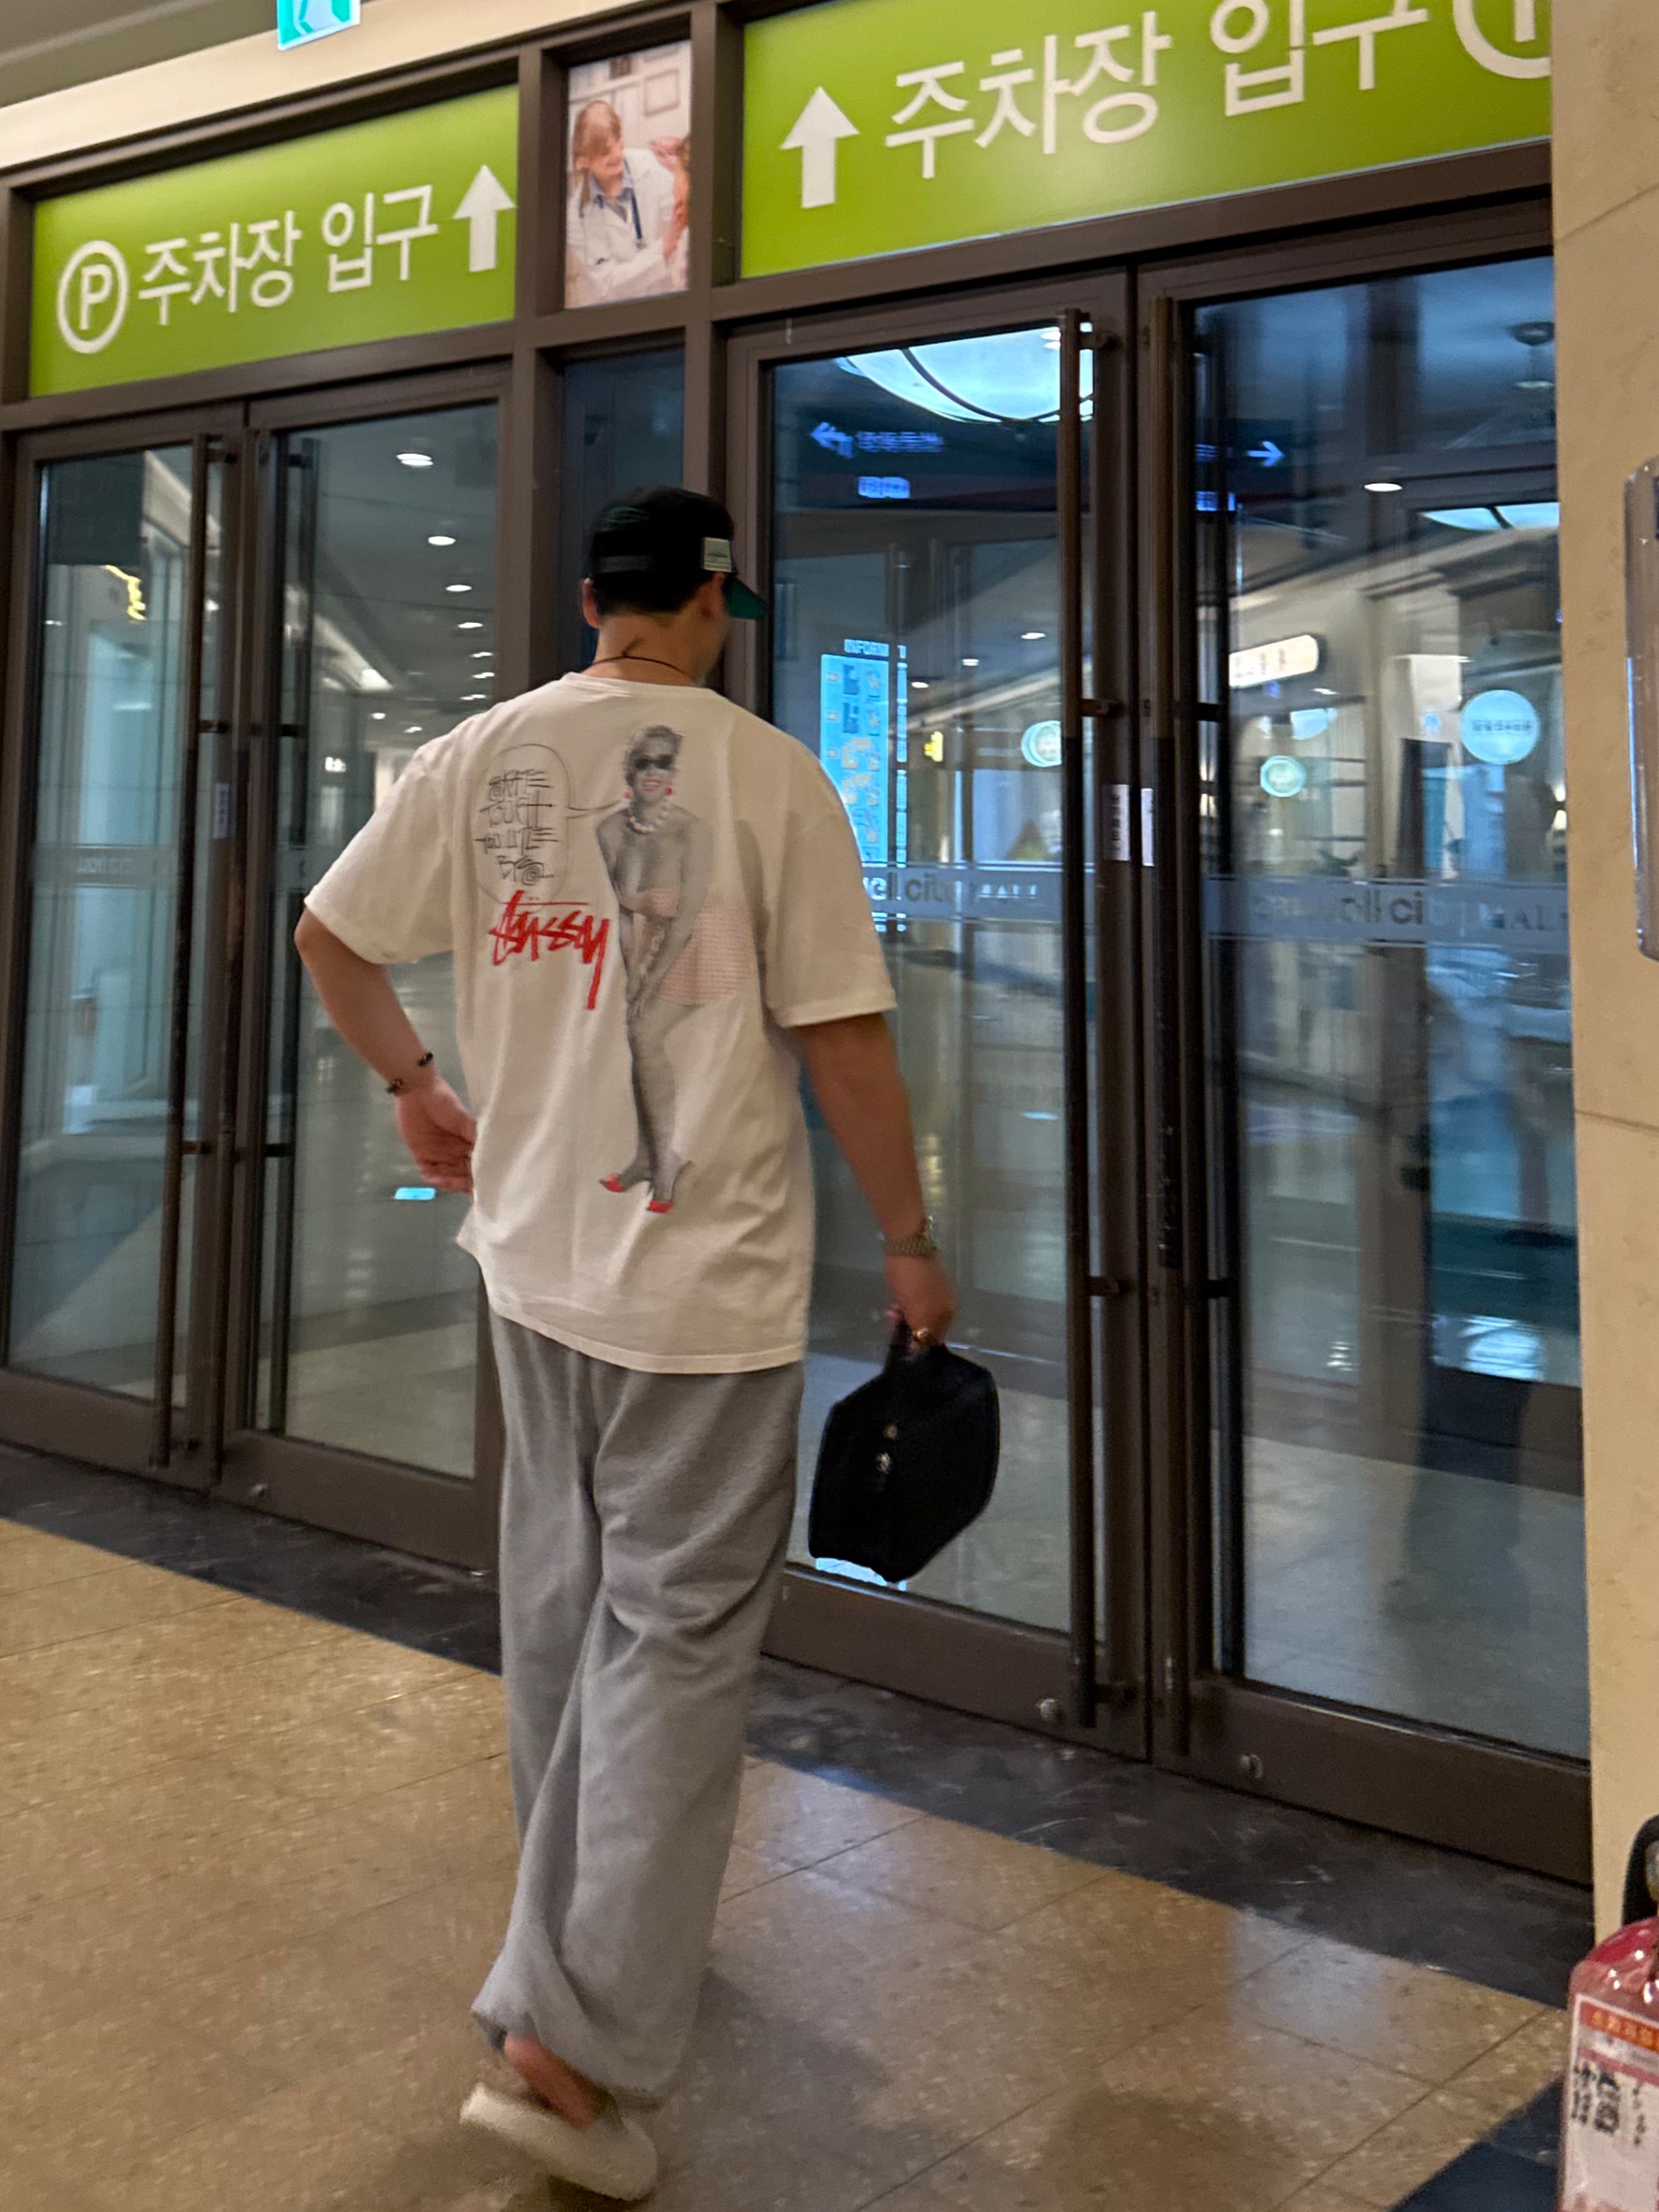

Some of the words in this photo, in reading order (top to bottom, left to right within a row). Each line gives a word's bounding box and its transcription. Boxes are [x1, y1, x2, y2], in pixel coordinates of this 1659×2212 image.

[886, 10, 1170, 178] 주차장
[138, 210, 302, 326] 주차장
[321, 185, 438, 293] 입구
